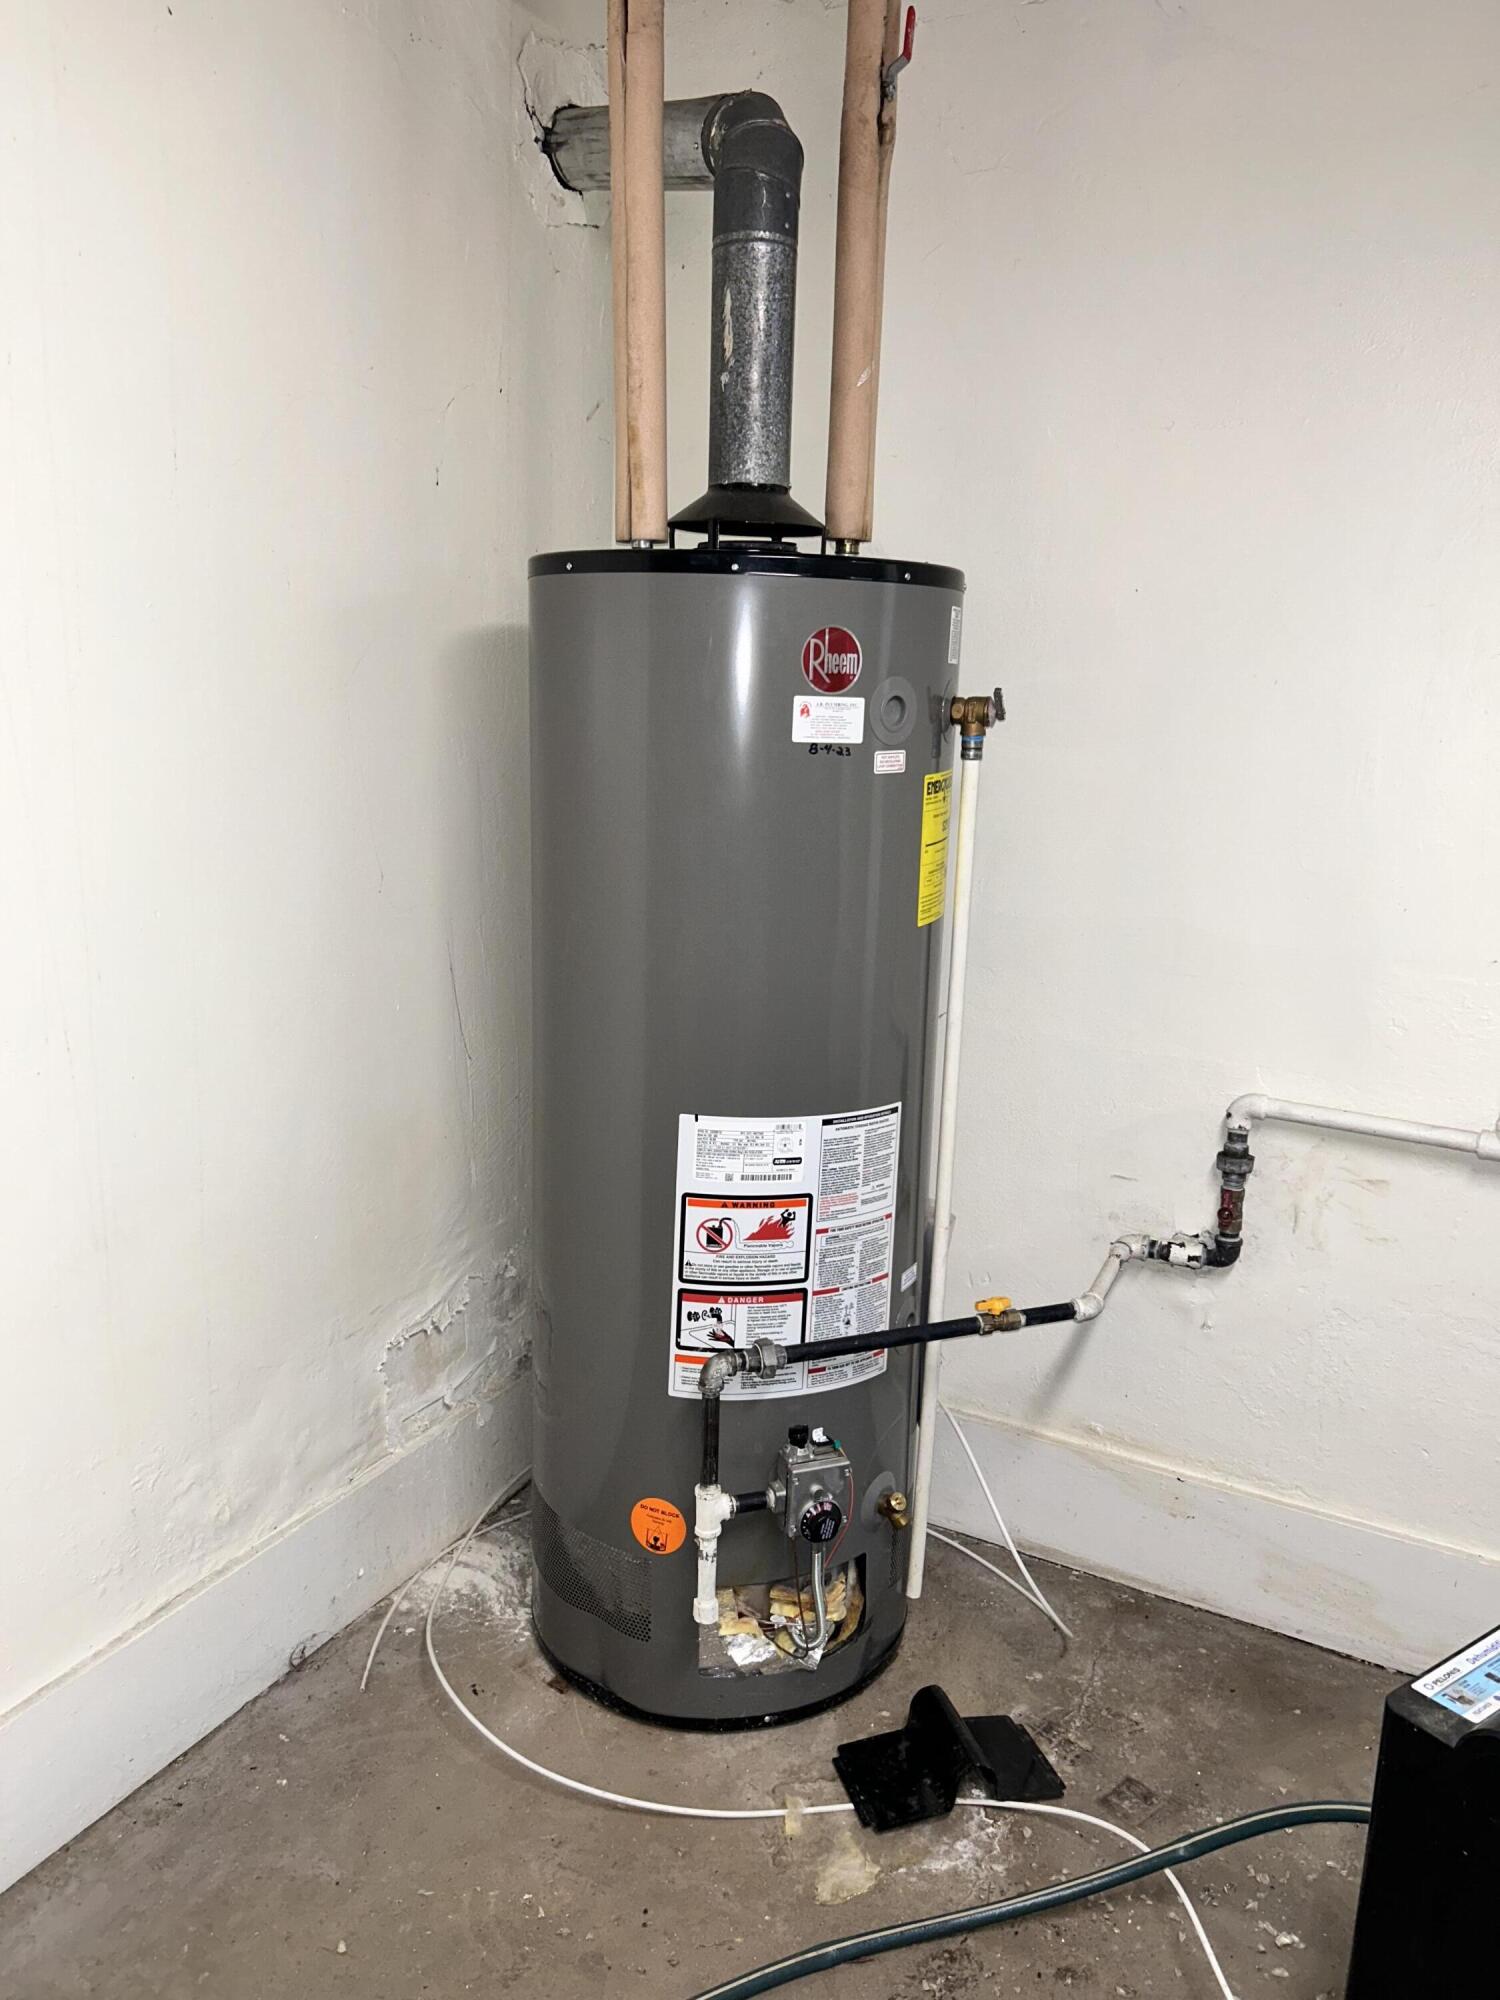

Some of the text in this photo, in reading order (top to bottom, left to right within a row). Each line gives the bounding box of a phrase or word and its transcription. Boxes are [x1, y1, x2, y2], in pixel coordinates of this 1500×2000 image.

[808, 628, 858, 683] Rheem
[809, 744, 851, 757] 8-4-23
[727, 1296, 764, 1304] DANGER
[661, 1510, 680, 1518] BLOCK
[1432, 1667, 1461, 1686] PELONIS
